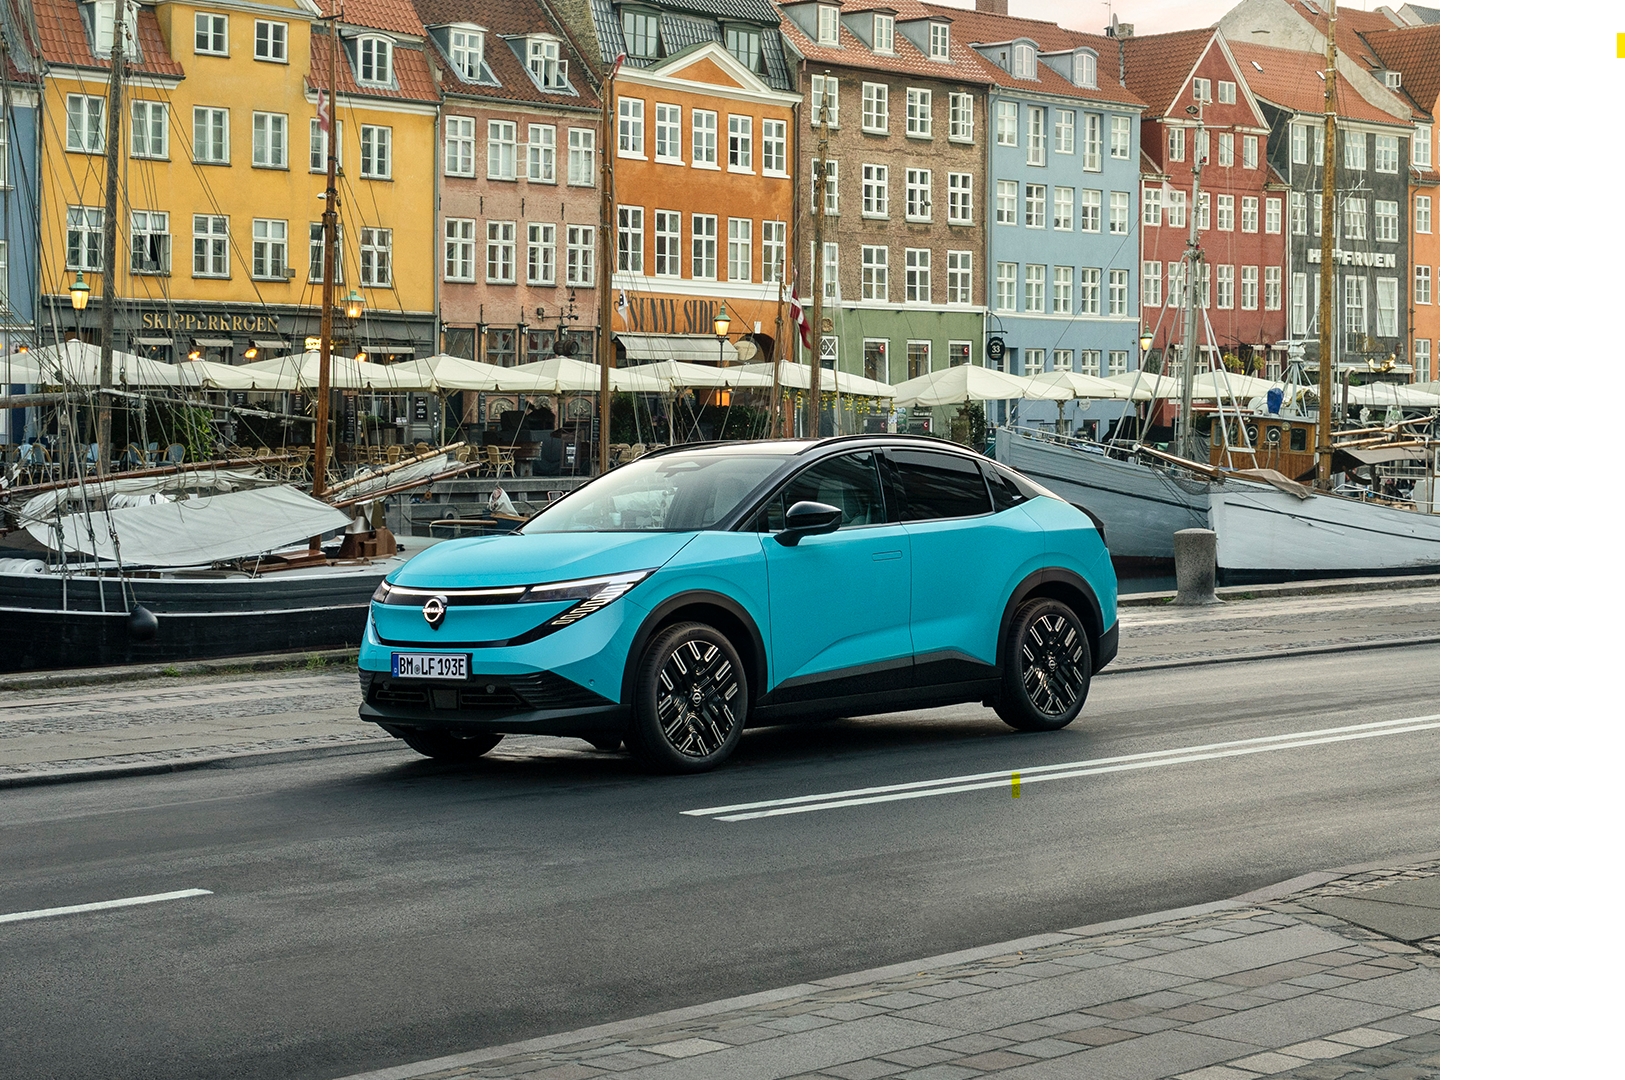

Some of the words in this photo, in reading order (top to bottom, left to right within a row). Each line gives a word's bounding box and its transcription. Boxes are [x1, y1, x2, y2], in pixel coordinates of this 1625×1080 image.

[1307, 249, 1395, 268] HFRUEN
[143, 313, 279, 332] SKIPPERKROEN
[629, 297, 680, 334] SUNNY
[683, 299, 718, 335] SIDE
[991, 345, 1001, 353] 33
[1239, 349, 1252, 362] 37
[399, 657, 414, 675] BM
[421, 657, 436, 676] LF
[437, 658, 466, 676] 193E
